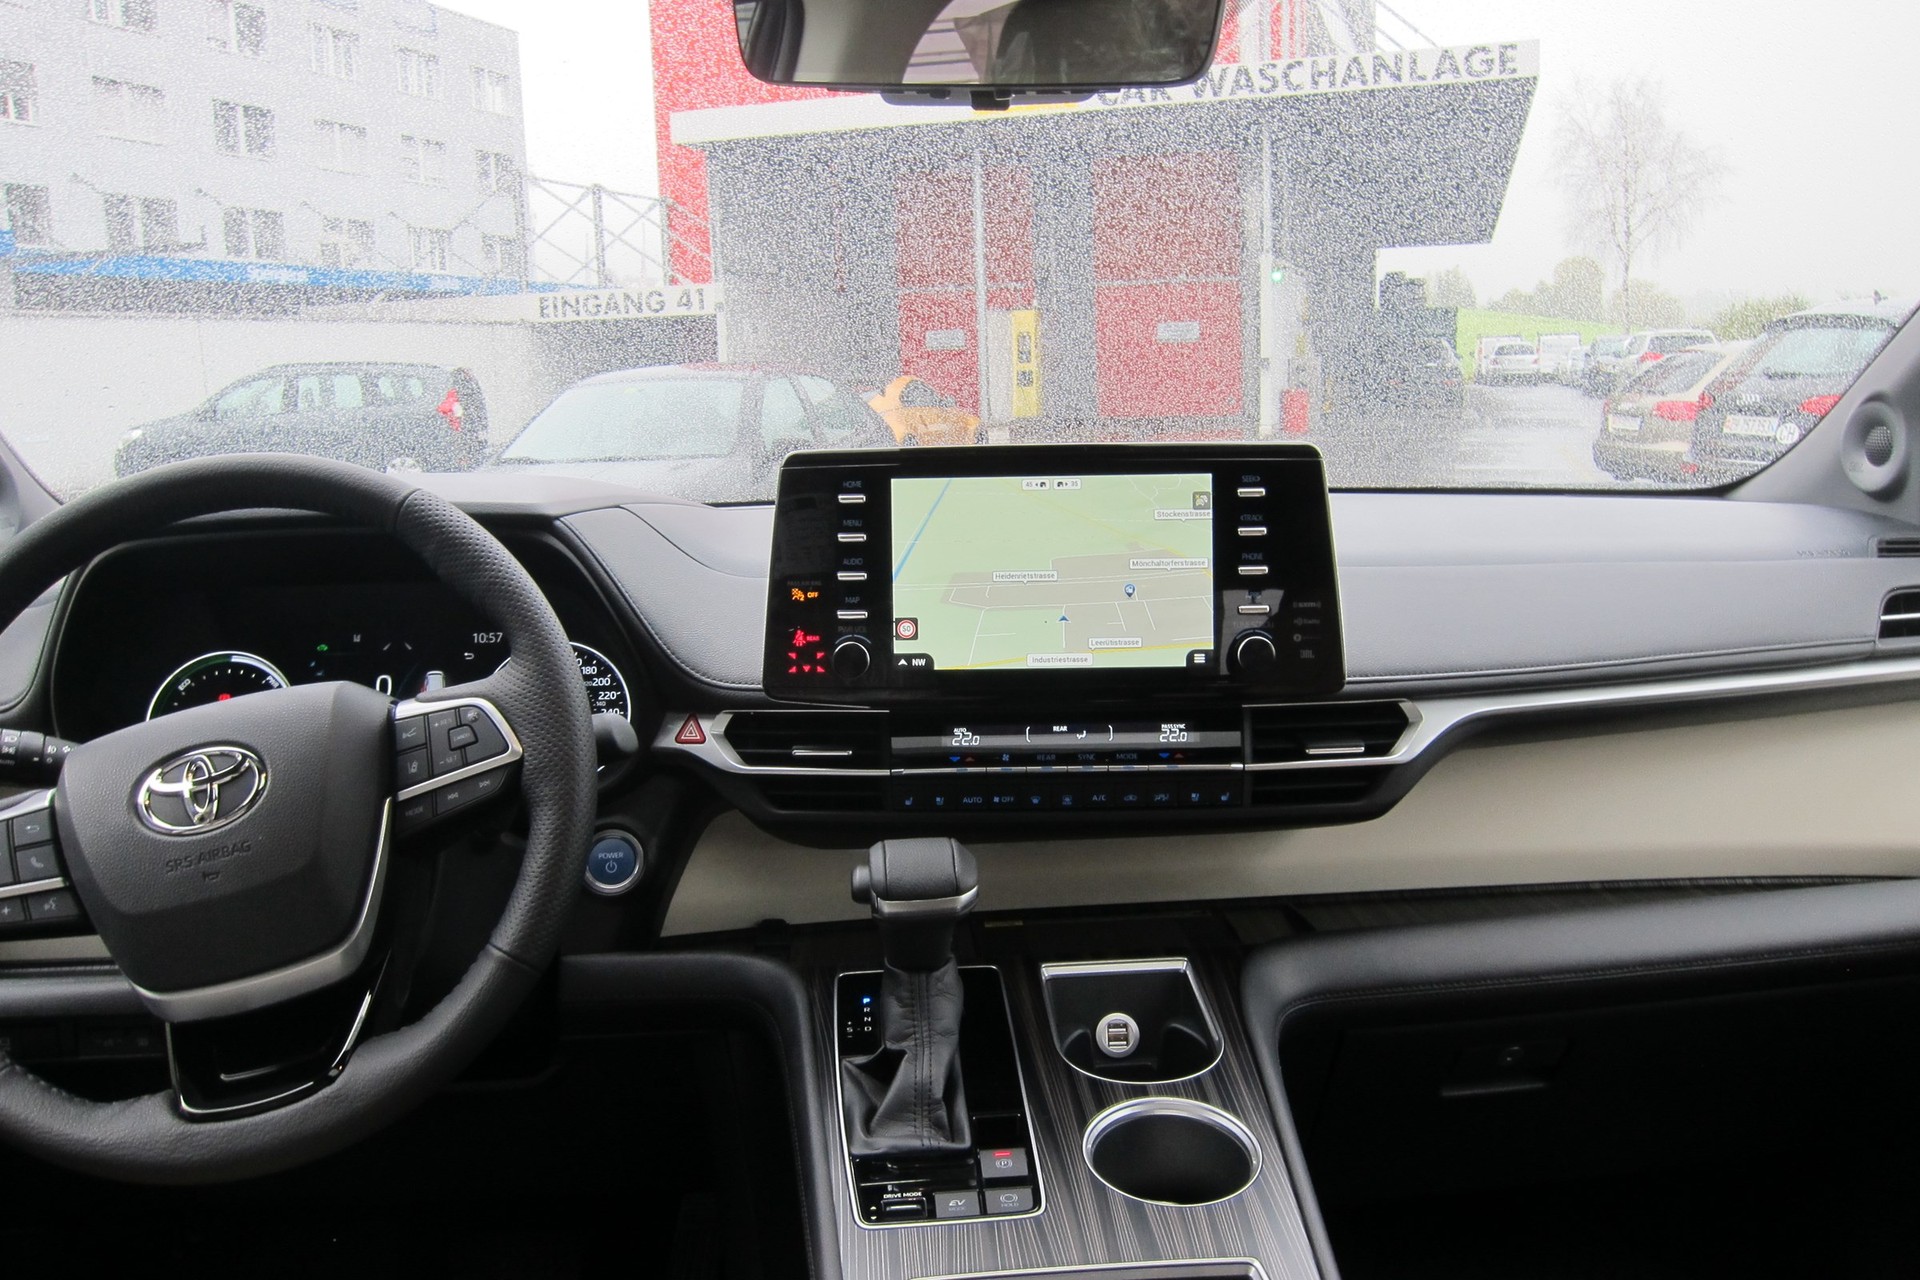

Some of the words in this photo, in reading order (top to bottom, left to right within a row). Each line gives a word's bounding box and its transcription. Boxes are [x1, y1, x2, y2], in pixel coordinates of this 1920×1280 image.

[1192, 43, 1518, 99] WASCHANLAGE
[539, 290, 666, 319] EINGANG
[677, 288, 705, 311] 41
[842, 480, 862, 488] HOME
[1156, 510, 1212, 518] Stockenstrasse
[842, 519, 863, 527] MENU
[994, 572, 1056, 580] Heidenrietstrasse
[845, 596, 860, 604] MAP
[902, 624, 911, 633] 50
[472, 632, 503, 644] 10:57
[912, 659, 927, 667] NW
[1031, 656, 1089, 664] Industriestrasse
[581, 666, 598, 675] 180
[178, 678, 191, 691] ECO
[592, 677, 611, 687] 200
[598, 690, 617, 700] 220
[952, 732, 980, 746] 22.0
[1159, 729, 1188, 742] 22.0
[165, 857, 193, 873] SRS
[197, 841, 251, 864] AIRBAG
